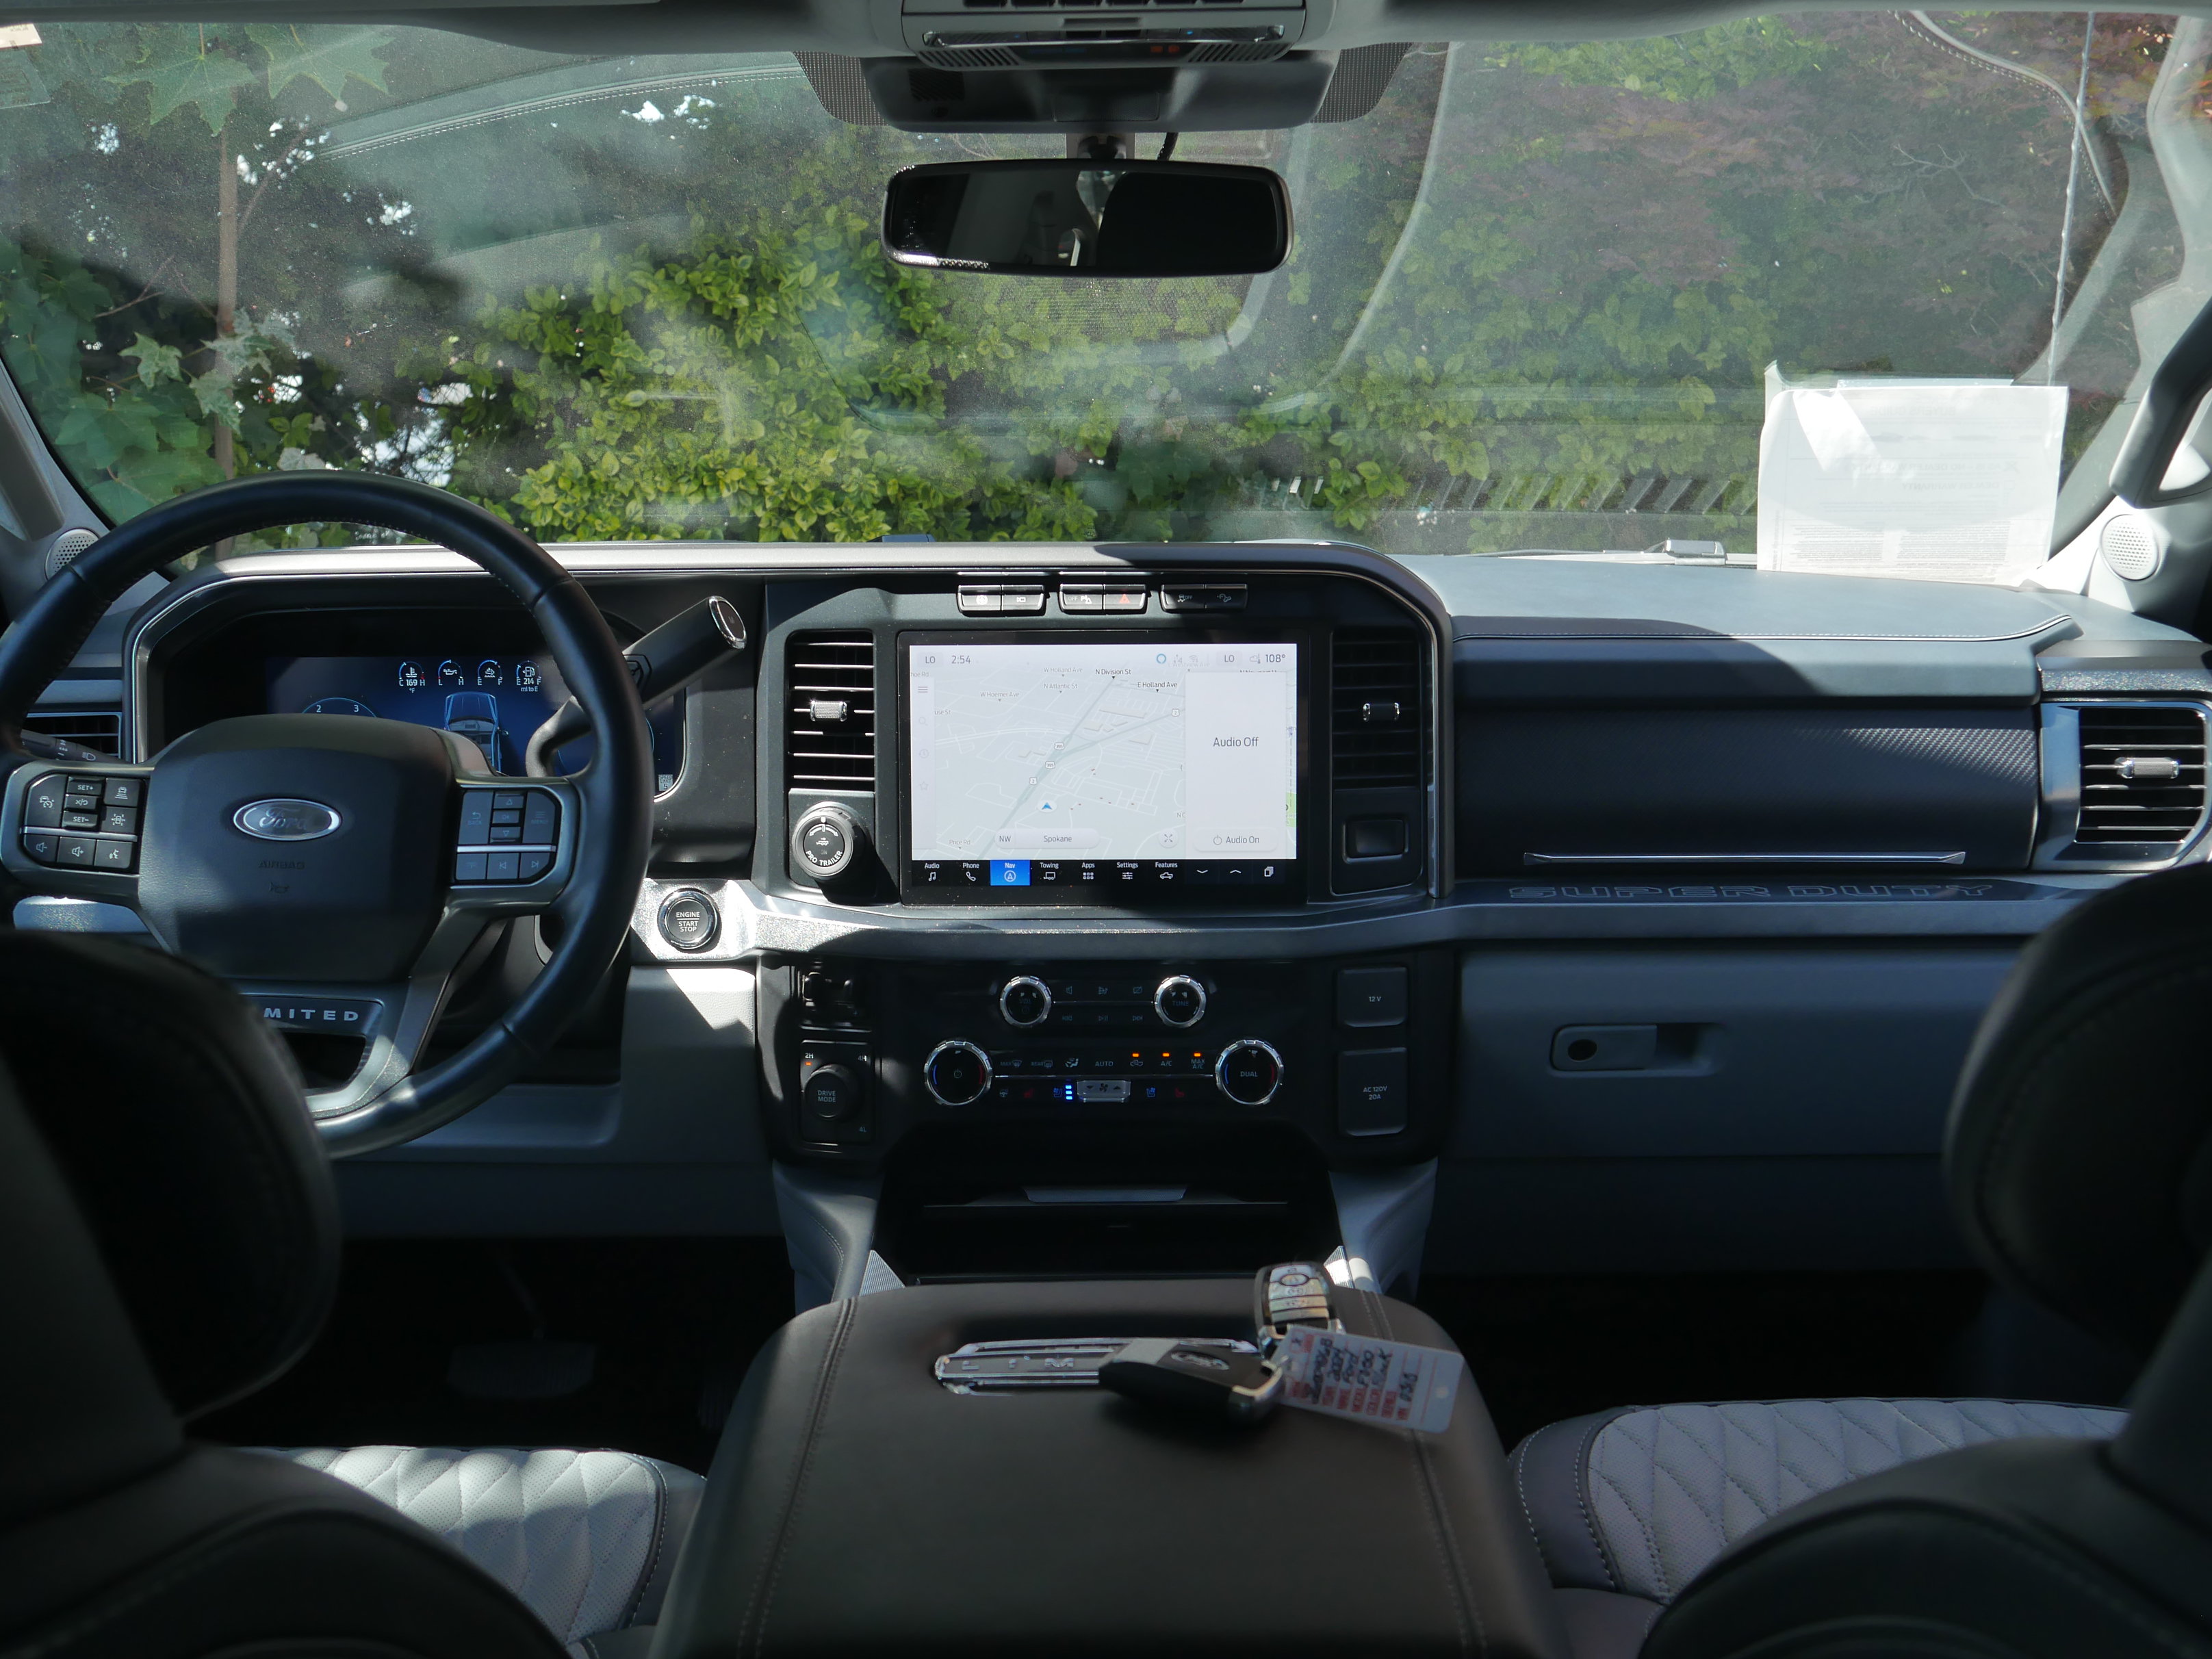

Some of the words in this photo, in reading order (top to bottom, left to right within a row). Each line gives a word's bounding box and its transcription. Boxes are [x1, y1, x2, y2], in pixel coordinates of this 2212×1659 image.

[925, 656, 936, 664] LO
[951, 655, 971, 664] 2:54
[316, 704, 322, 712] 2
[354, 704, 359, 712] 3
[1213, 736, 1242, 747] Audio
[1244, 736, 1259, 747] Off
[259, 806, 311, 830] Ford
[1044, 835, 1072, 844] Spokane
[1226, 836, 1247, 844] Audio
[1248, 836, 1260, 844] On
[806, 850, 818, 863] PRO
[819, 850, 843, 866] TRAILER
[259, 860, 305, 870] AIRBAG
[1509, 886, 1771, 898] SUPER
[1787, 885, 1993, 897] DUTY
[263, 1007, 359, 1021] MITED
